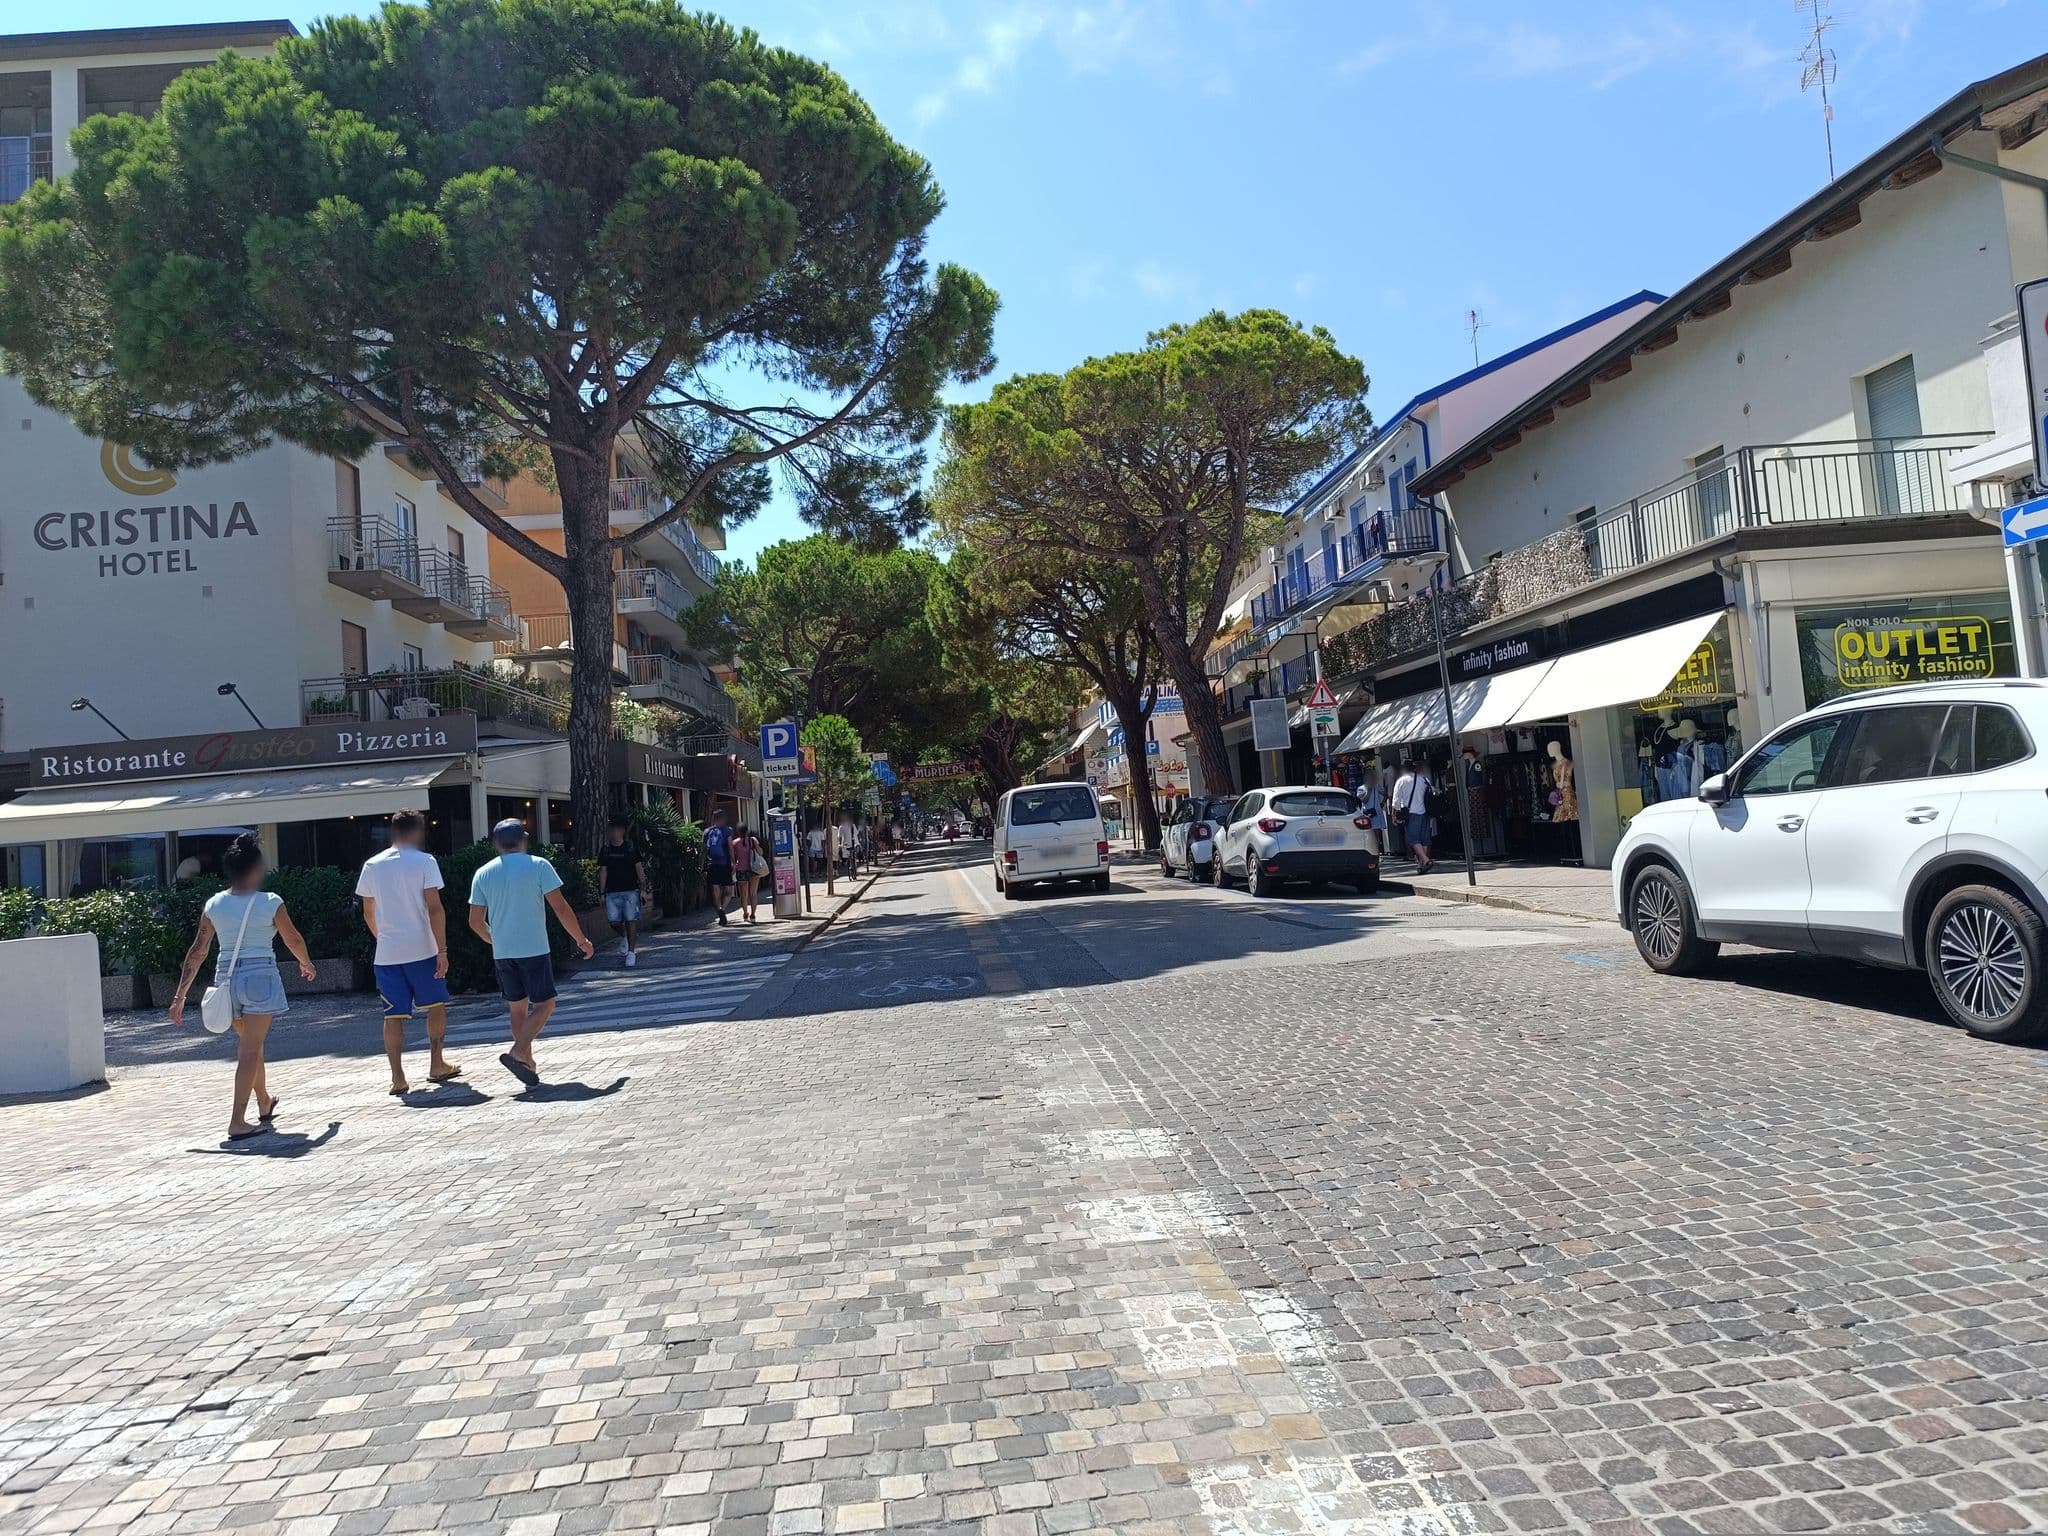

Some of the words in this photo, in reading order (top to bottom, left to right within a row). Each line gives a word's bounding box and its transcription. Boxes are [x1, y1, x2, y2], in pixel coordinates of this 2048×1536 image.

[33, 501, 259, 551] CRISTINA
[99, 549, 198, 577] HOTEL
[1846, 618, 1870, 627] NON
[1872, 616, 1901, 626] SOLO
[1462, 650, 1492, 671] infinity
[1494, 640, 1529, 662] fashion
[1840, 626, 1982, 660] OUTLET
[1844, 660, 1910, 679] infinity
[1918, 656, 1986, 674] fashion
[1677, 680, 1714, 694] fashion
[41, 749, 186, 778] Ristorante
[336, 726, 448, 753] Pizzeria
[767, 728, 789, 756] P
[644, 753, 685, 780] Ristorante
[766, 764, 796, 773] tickets
[914, 763, 966, 779] MURDERS
